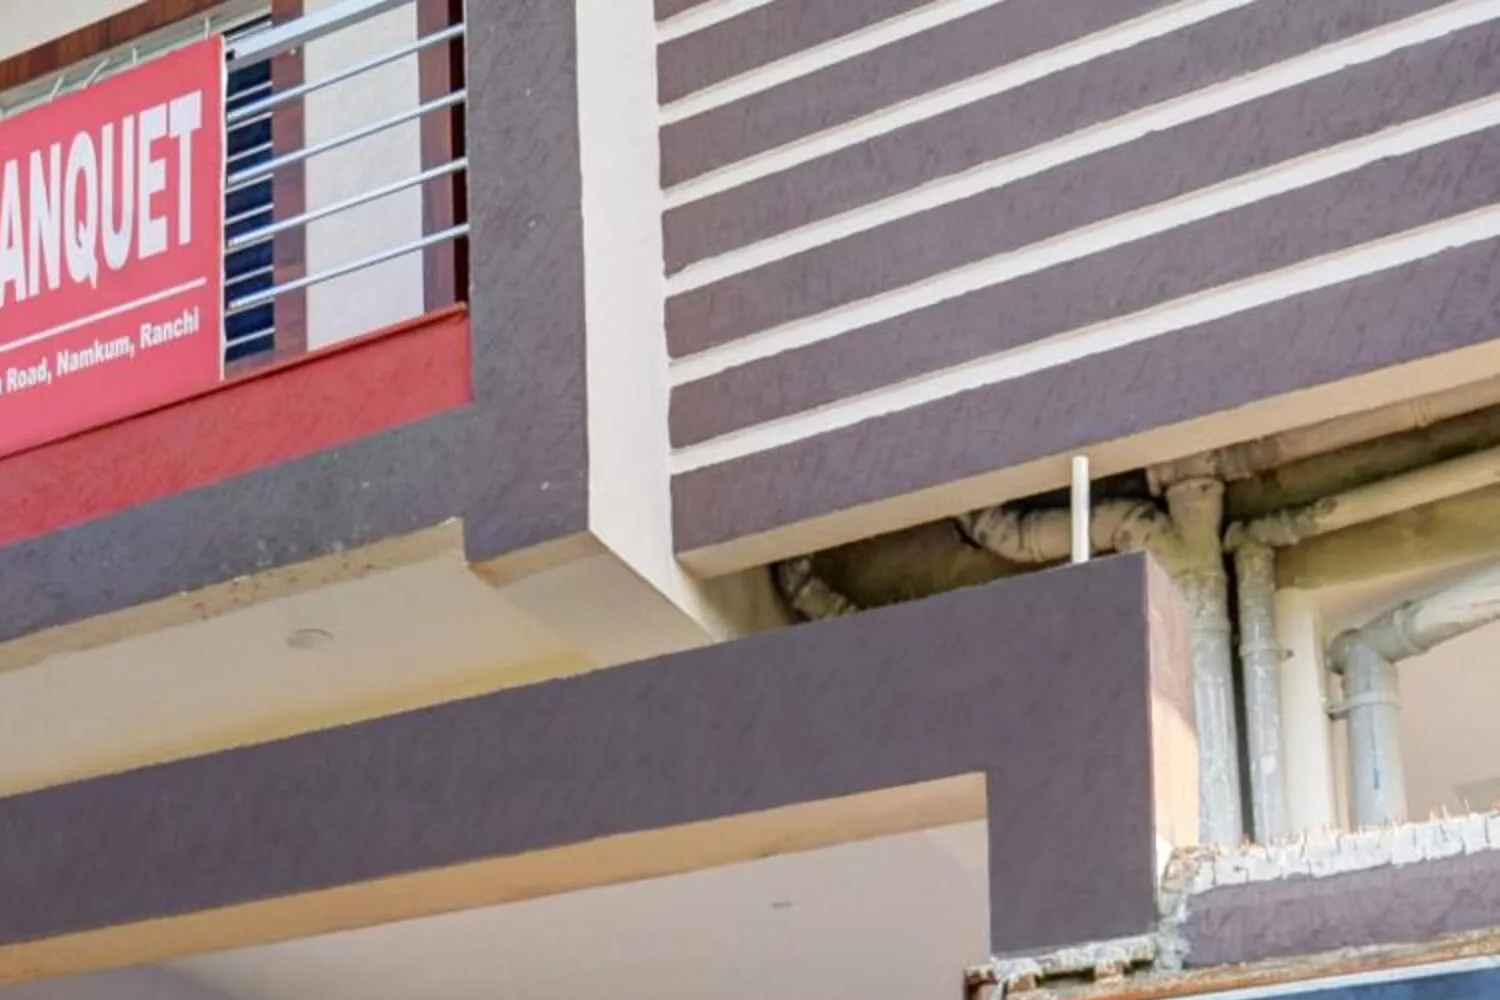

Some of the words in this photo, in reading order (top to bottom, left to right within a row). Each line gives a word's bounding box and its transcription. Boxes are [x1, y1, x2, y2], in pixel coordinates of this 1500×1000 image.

[6, 356, 52, 393] Road,
[56, 335, 135, 378] Namkum,
[140, 306, 200, 350] Ranchi
